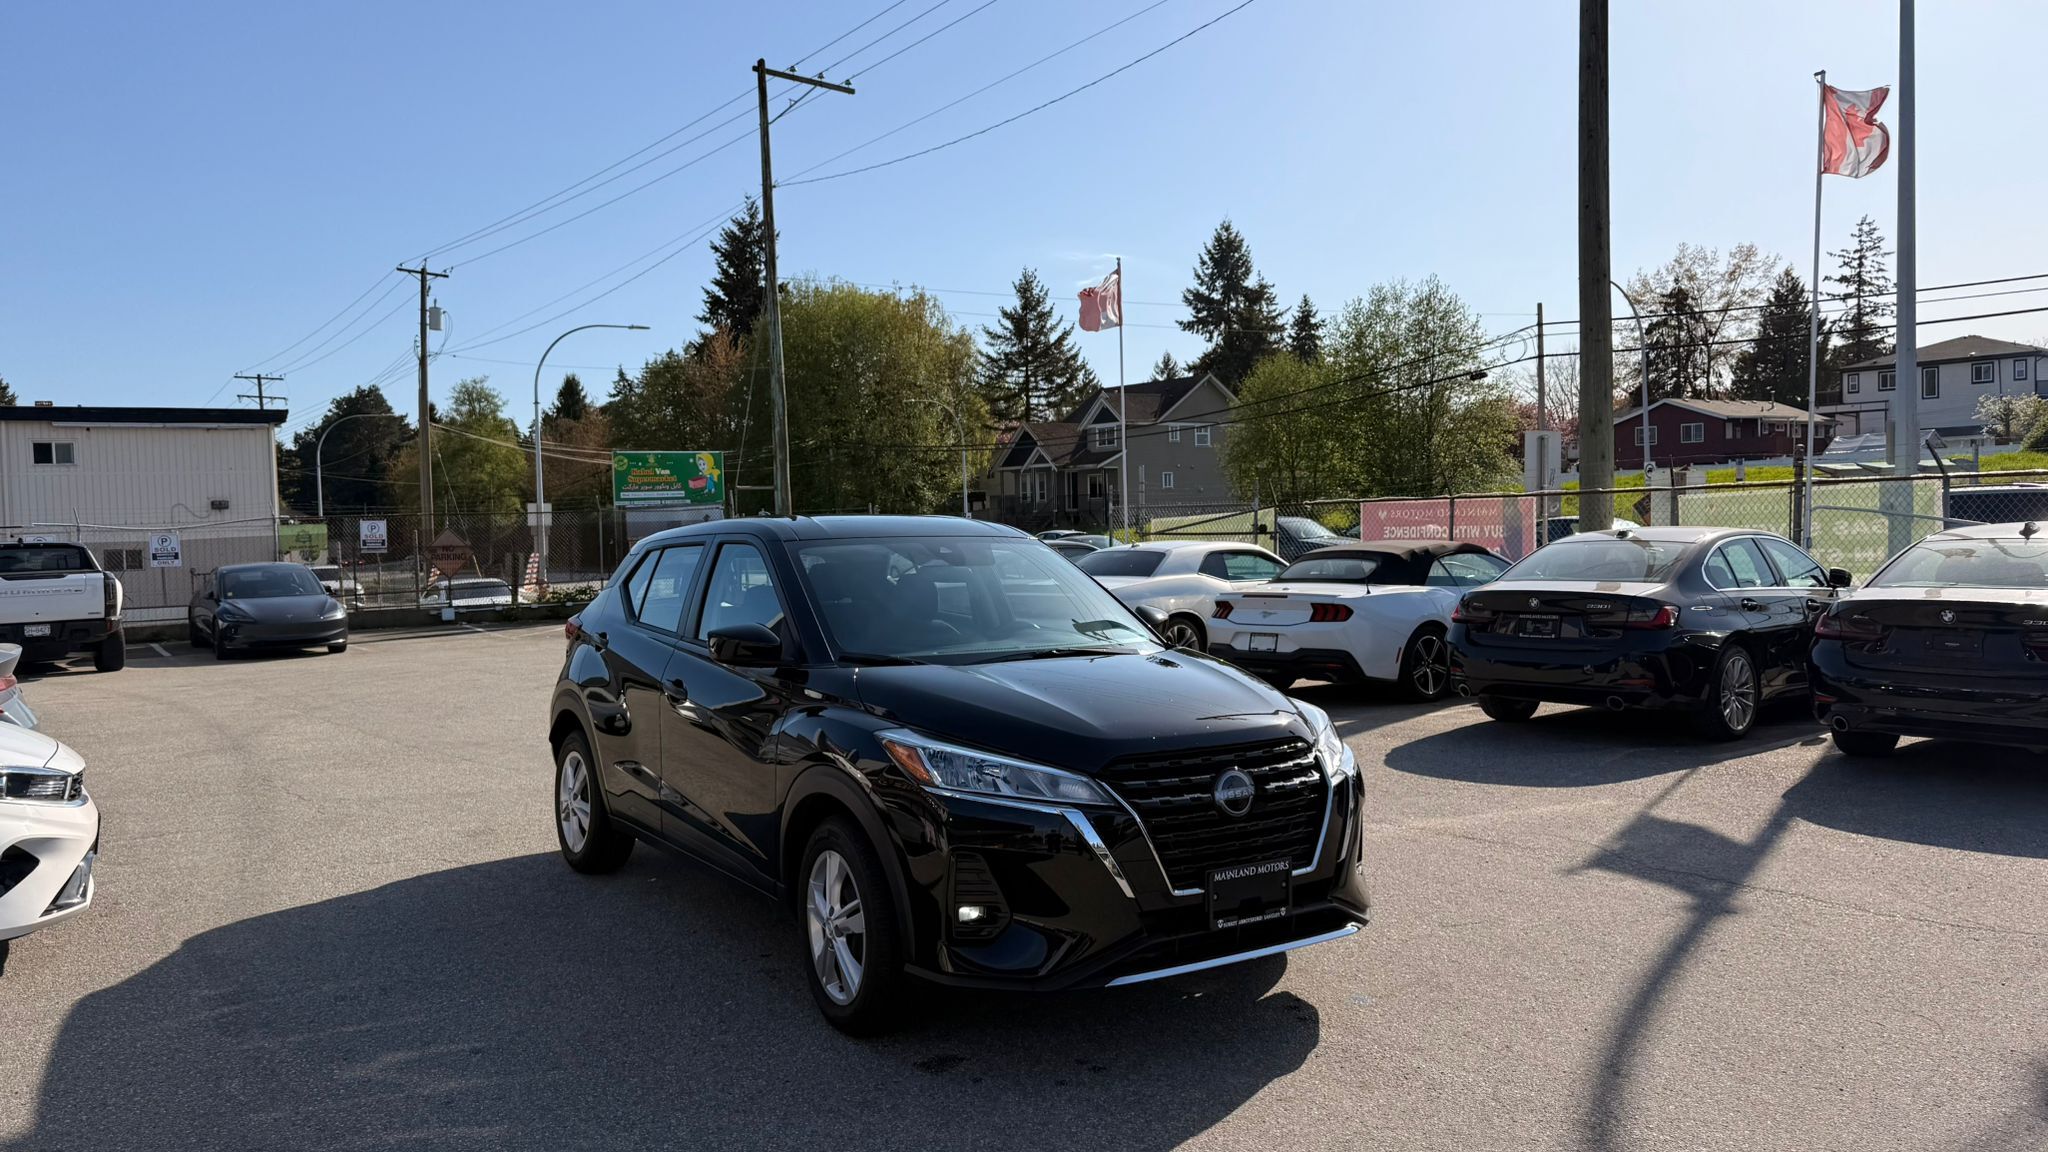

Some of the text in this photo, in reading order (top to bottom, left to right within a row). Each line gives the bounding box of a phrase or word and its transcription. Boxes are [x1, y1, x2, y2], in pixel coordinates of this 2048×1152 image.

[431, 552, 467, 561] PARKING
[1214, 861, 1290, 882] MAINLAND MOTORS
